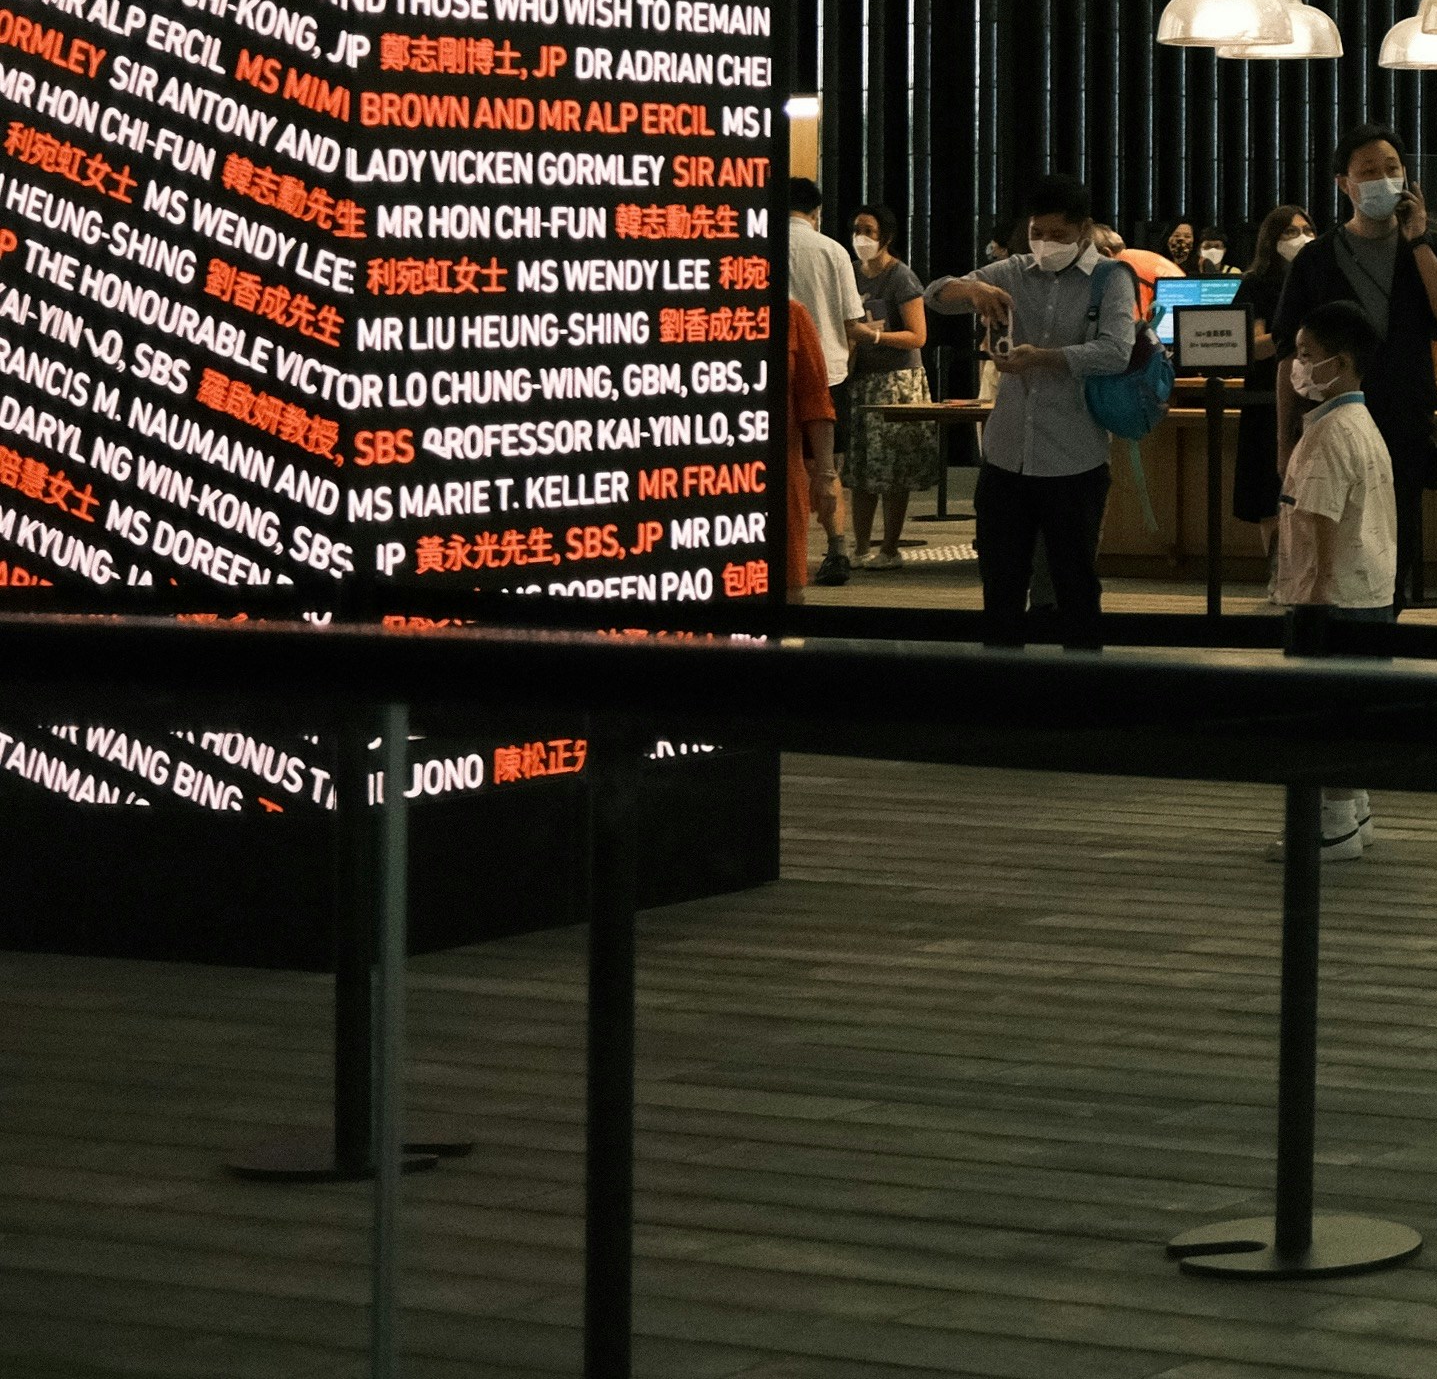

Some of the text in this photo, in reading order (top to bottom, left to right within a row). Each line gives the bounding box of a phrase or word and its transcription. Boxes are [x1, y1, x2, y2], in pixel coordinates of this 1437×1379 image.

[675, 1, 770, 36] REMAIN
[146, 14, 225, 74] ERCIL
[235, 49, 282, 94] MS
[283, 68, 350, 122] MIMI
[360, 92, 469, 128] BROWN
[474, 97, 534, 130] AND
[539, 99, 581, 131] MR
[584, 101, 638, 133] ALP
[642, 103, 715, 136] ERCIL
[723, 106, 760, 138] MS
[377, 205, 423, 238] MR
[429, 205, 490, 239] HON
[495, 205, 606, 239] CHI-FUN
[518, 259, 558, 293] MS
[563, 260, 659, 291] WENDY
[663, 259, 710, 290] LEE
[25, 239, 749, 410] THE HONOURABLE VICTOR LO CHUNG-WING, GBM, GBS,
[93, 382, 678, 522] M. NAUMANN AND MS MARIE T. KELLER MR
[566, 524, 626, 560] SBS,
[630, 521, 663, 554] JP
[671, 517, 710, 550] MR
[86, 727, 170, 785] WANG
